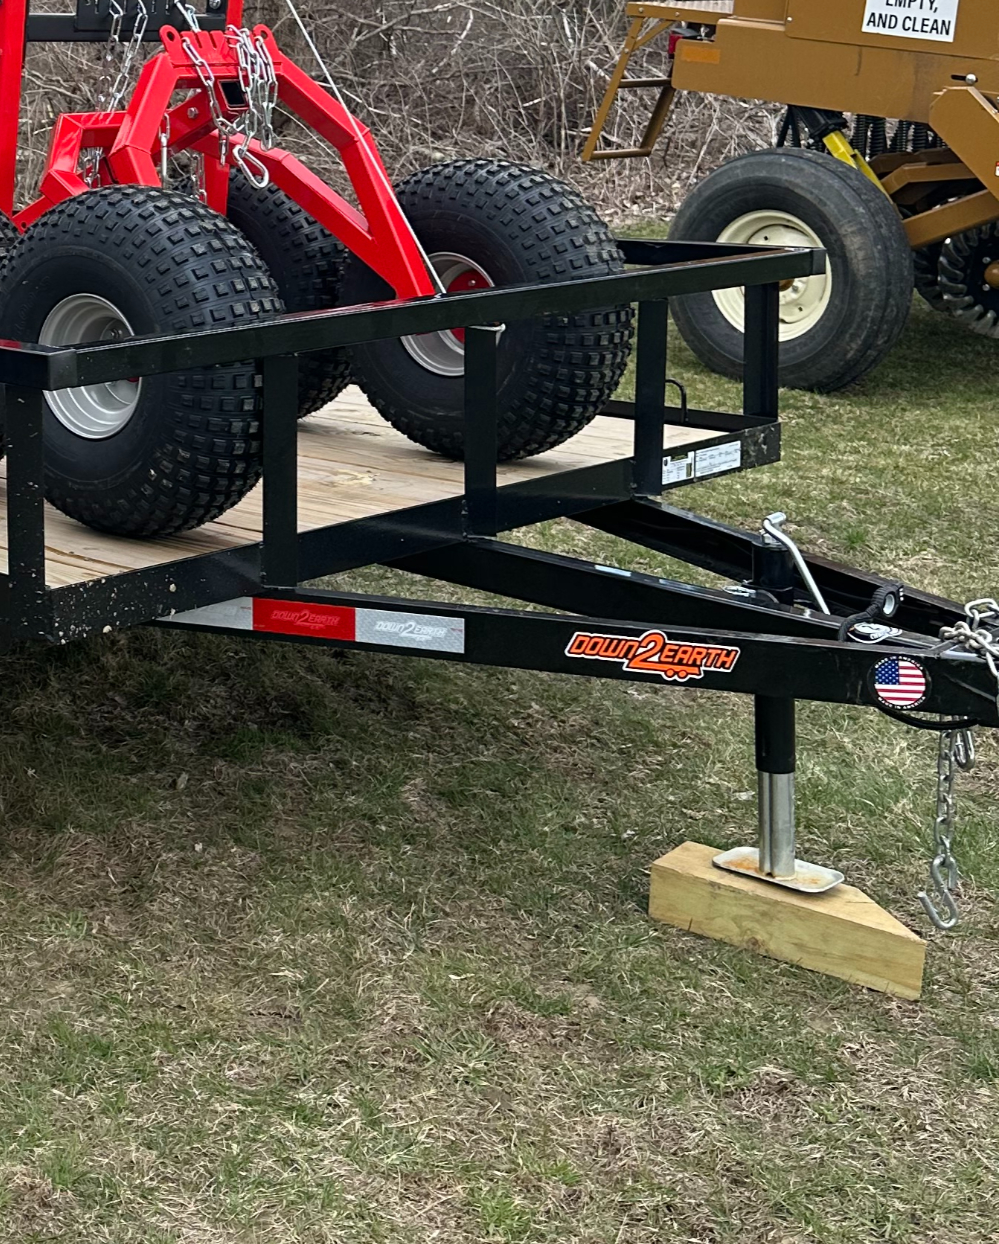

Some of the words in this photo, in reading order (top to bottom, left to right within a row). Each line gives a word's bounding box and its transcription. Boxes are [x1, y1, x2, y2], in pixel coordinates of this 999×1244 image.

[866, 11, 898, 30] AND
[901, 15, 952, 36] CLEAN
[567, 630, 740, 678] DOWN2EARTH
